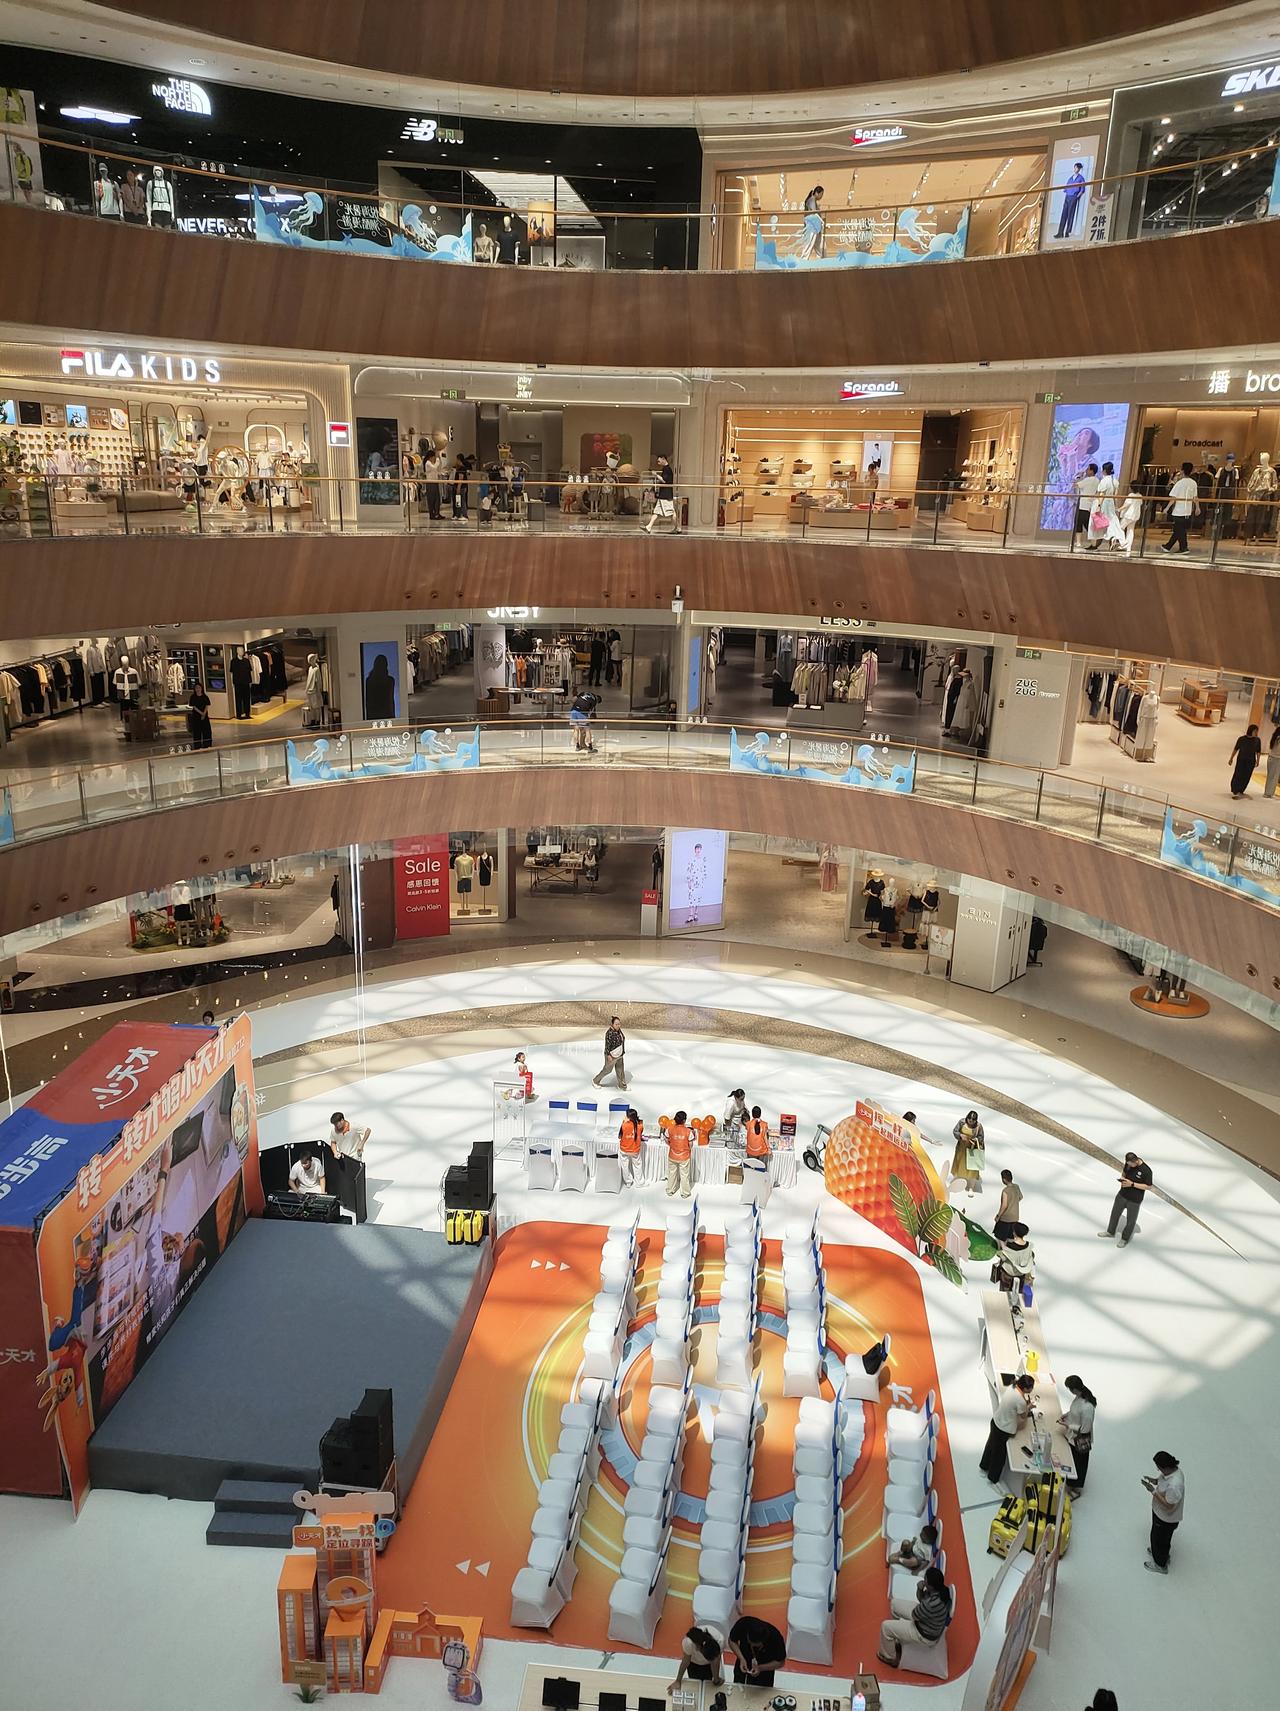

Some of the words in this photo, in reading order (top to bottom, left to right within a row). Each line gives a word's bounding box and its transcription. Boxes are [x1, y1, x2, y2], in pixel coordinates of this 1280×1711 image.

[168, 77, 191, 91] THE
[152, 84, 191, 101] NORTH
[165, 96, 192, 112] FACE
[855, 126, 903, 141] Sprandi
[1091, 215, 1107, 228] 2件
[1090, 228, 1106, 241] 7折
[61, 350, 134, 378] FILA
[141, 354, 221, 383] KIDS
[843, 380, 899, 395] Sprandi
[1208, 369, 1231, 394] 播
[1184, 440, 1223, 448] broadcast
[1016, 679, 1038, 688] ZUC
[1015, 687, 1037, 697] ZUG
[405, 857, 441, 875] Sale
[405, 904, 427, 913] Calvin
[426, 903, 442, 911] Klein
